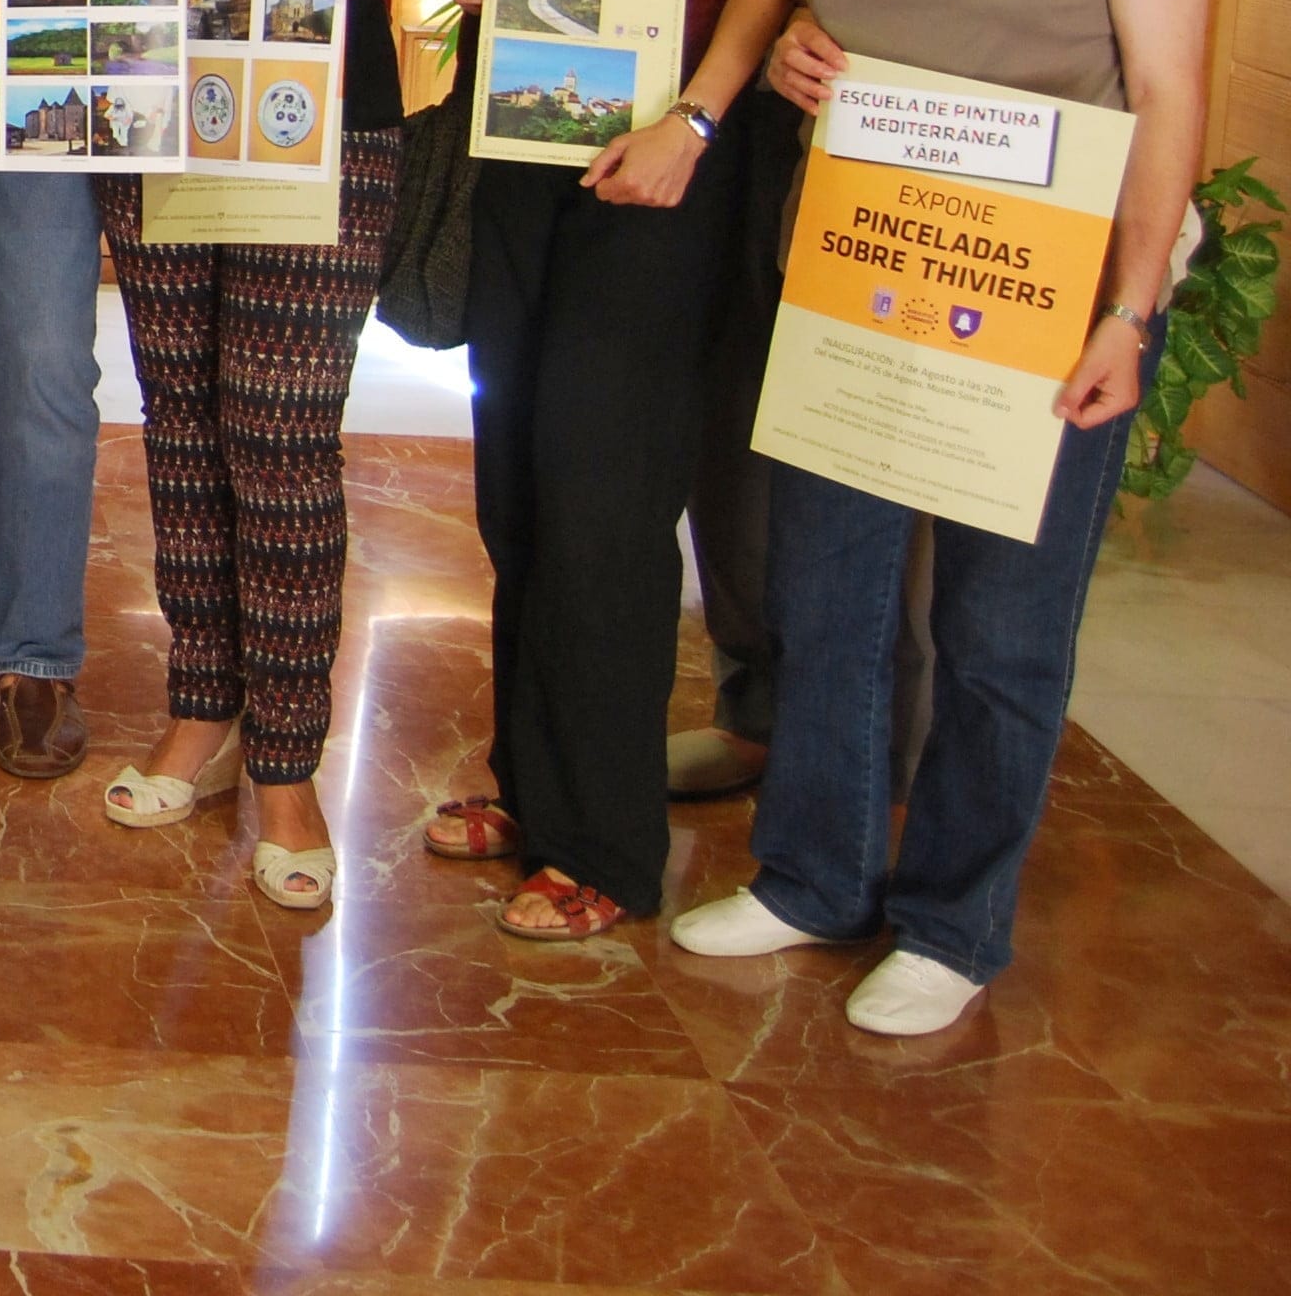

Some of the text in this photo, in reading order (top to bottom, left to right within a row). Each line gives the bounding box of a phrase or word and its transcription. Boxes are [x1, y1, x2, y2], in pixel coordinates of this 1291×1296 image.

[839, 90, 1041, 128] ESCUELA DE PINTURA
[860, 115, 1011, 148] MEDITERRÁNEA
[898, 184, 997, 225] EXPONE
[853, 206, 1032, 271] PINCELADAS
[821, 230, 1057, 311] SOBRE THIVIERS
[907, 362, 919, 374] de
[921, 367, 957, 385] Agosto
[959, 378, 965, 386] a
[967, 378, 982, 392] las
[927, 382, 956, 397] Museo
[981, 396, 1011, 413] Blasco
